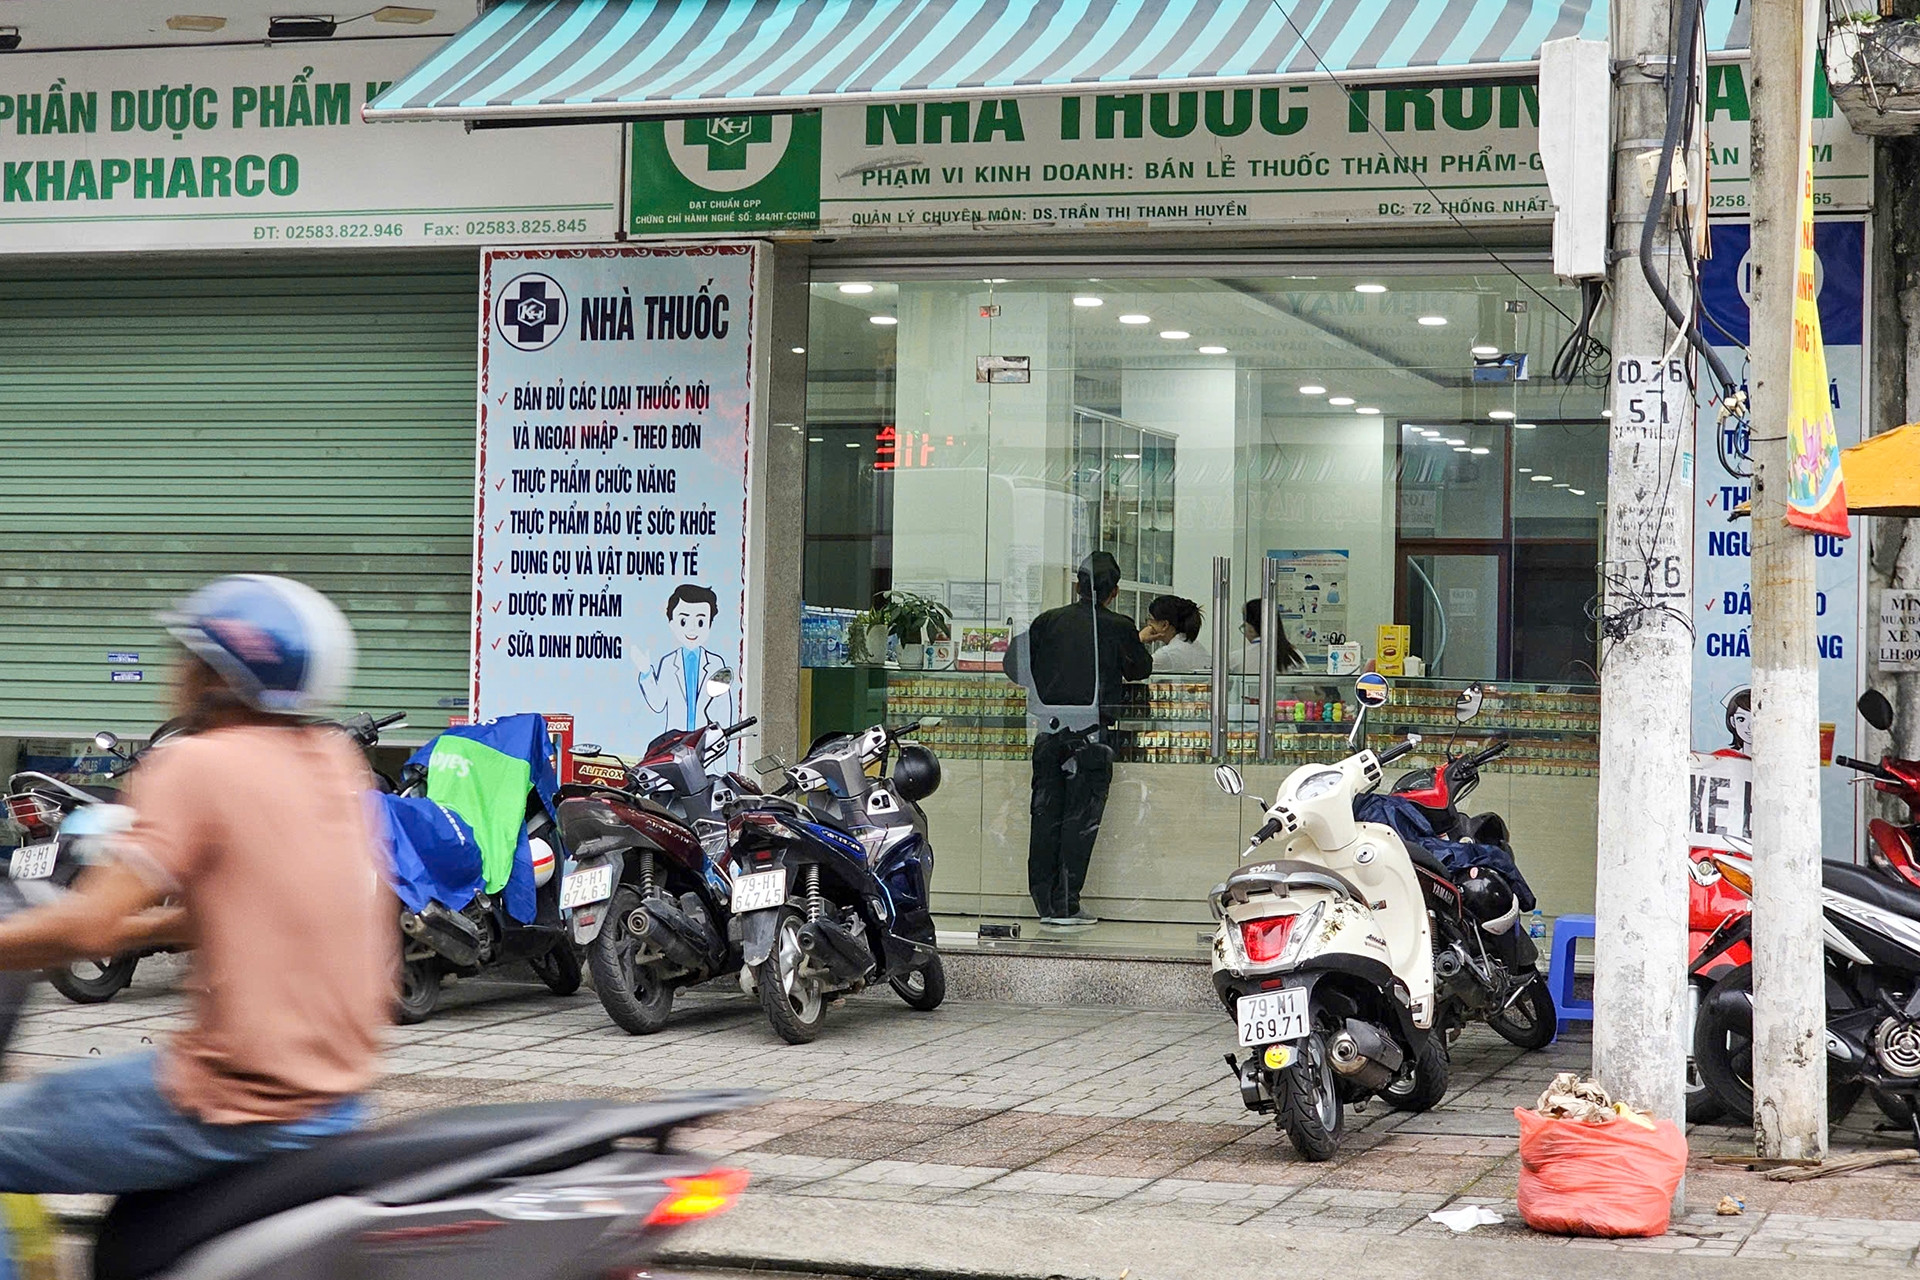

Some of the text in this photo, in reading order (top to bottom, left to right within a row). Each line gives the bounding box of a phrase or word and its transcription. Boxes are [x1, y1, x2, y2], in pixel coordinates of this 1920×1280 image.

[110, 84, 218, 140] DƯỢC
[232, 65, 351, 130] PHẨM
[3, 153, 299, 202] KHAPHARCO
[862, 168, 931, 188] PHẠM
[943, 167, 964, 184] VI
[975, 165, 1031, 183] KINH
[1043, 163, 1132, 182] DOANH:
[1145, 157, 1194, 180] BÁN
[1206, 154, 1236, 178] LẺ
[1248, 151, 1331, 177] THUỐC
[1341, 152, 1428, 175] THÀNH
[684, 212, 708, 223] HÀNH
[743, 200, 762, 208] GPP
[852, 208, 891, 226] QUẢN
[898, 207, 915, 224] LÝ
[922, 206, 981, 223] CHUYÊN
[988, 205, 1026, 221] MÔN:
[1106, 206, 1131, 222] THỊ
[1137, 205, 1189, 218] THANH
[1413, 202, 1431, 215] 72
[1440, 197, 1495, 214] THỐNG
[253, 218, 587, 240] ĐT: 02583.822.946 Fax: 02583.825.845
[580, 278, 730, 341] NHÀ THUỐC
[514, 376, 710, 416] BÁN ĐỦ CÁC LOẠI THUỐC NỘI
[513, 421, 530, 450] VÀ
[535, 426, 575, 455] NGOẠI
[581, 420, 618, 455] NHẬP
[633, 425, 667, 450] THEO
[672, 422, 701, 450] ĐƠN
[512, 459, 676, 498] THỰC PHẨM CHỨC NĂNG
[510, 501, 716, 541] THỰC PHẨM BẢO VỆ SỨC KHỎE
[511, 543, 700, 581] DỤNG CỤ VÀ VẬT DỤNG Y TẾ
[508, 584, 622, 621] DƯỢC MỸ PHẨM
[508, 630, 622, 660] SỮA DINH DƯỠNG
[579, 765, 625, 780] ALITROX
[20, 847, 49, 864] 79-H1
[1249, 864, 1276, 875] SYM
[570, 870, 604, 890] 79-H1
[742, 874, 777, 893] 79-H1
[564, 884, 607, 907] 974.63
[735, 889, 782, 909] 647.45
[1249, 993, 1295, 1020] 79-N1
[1244, 1014, 1303, 1042] 269.71
